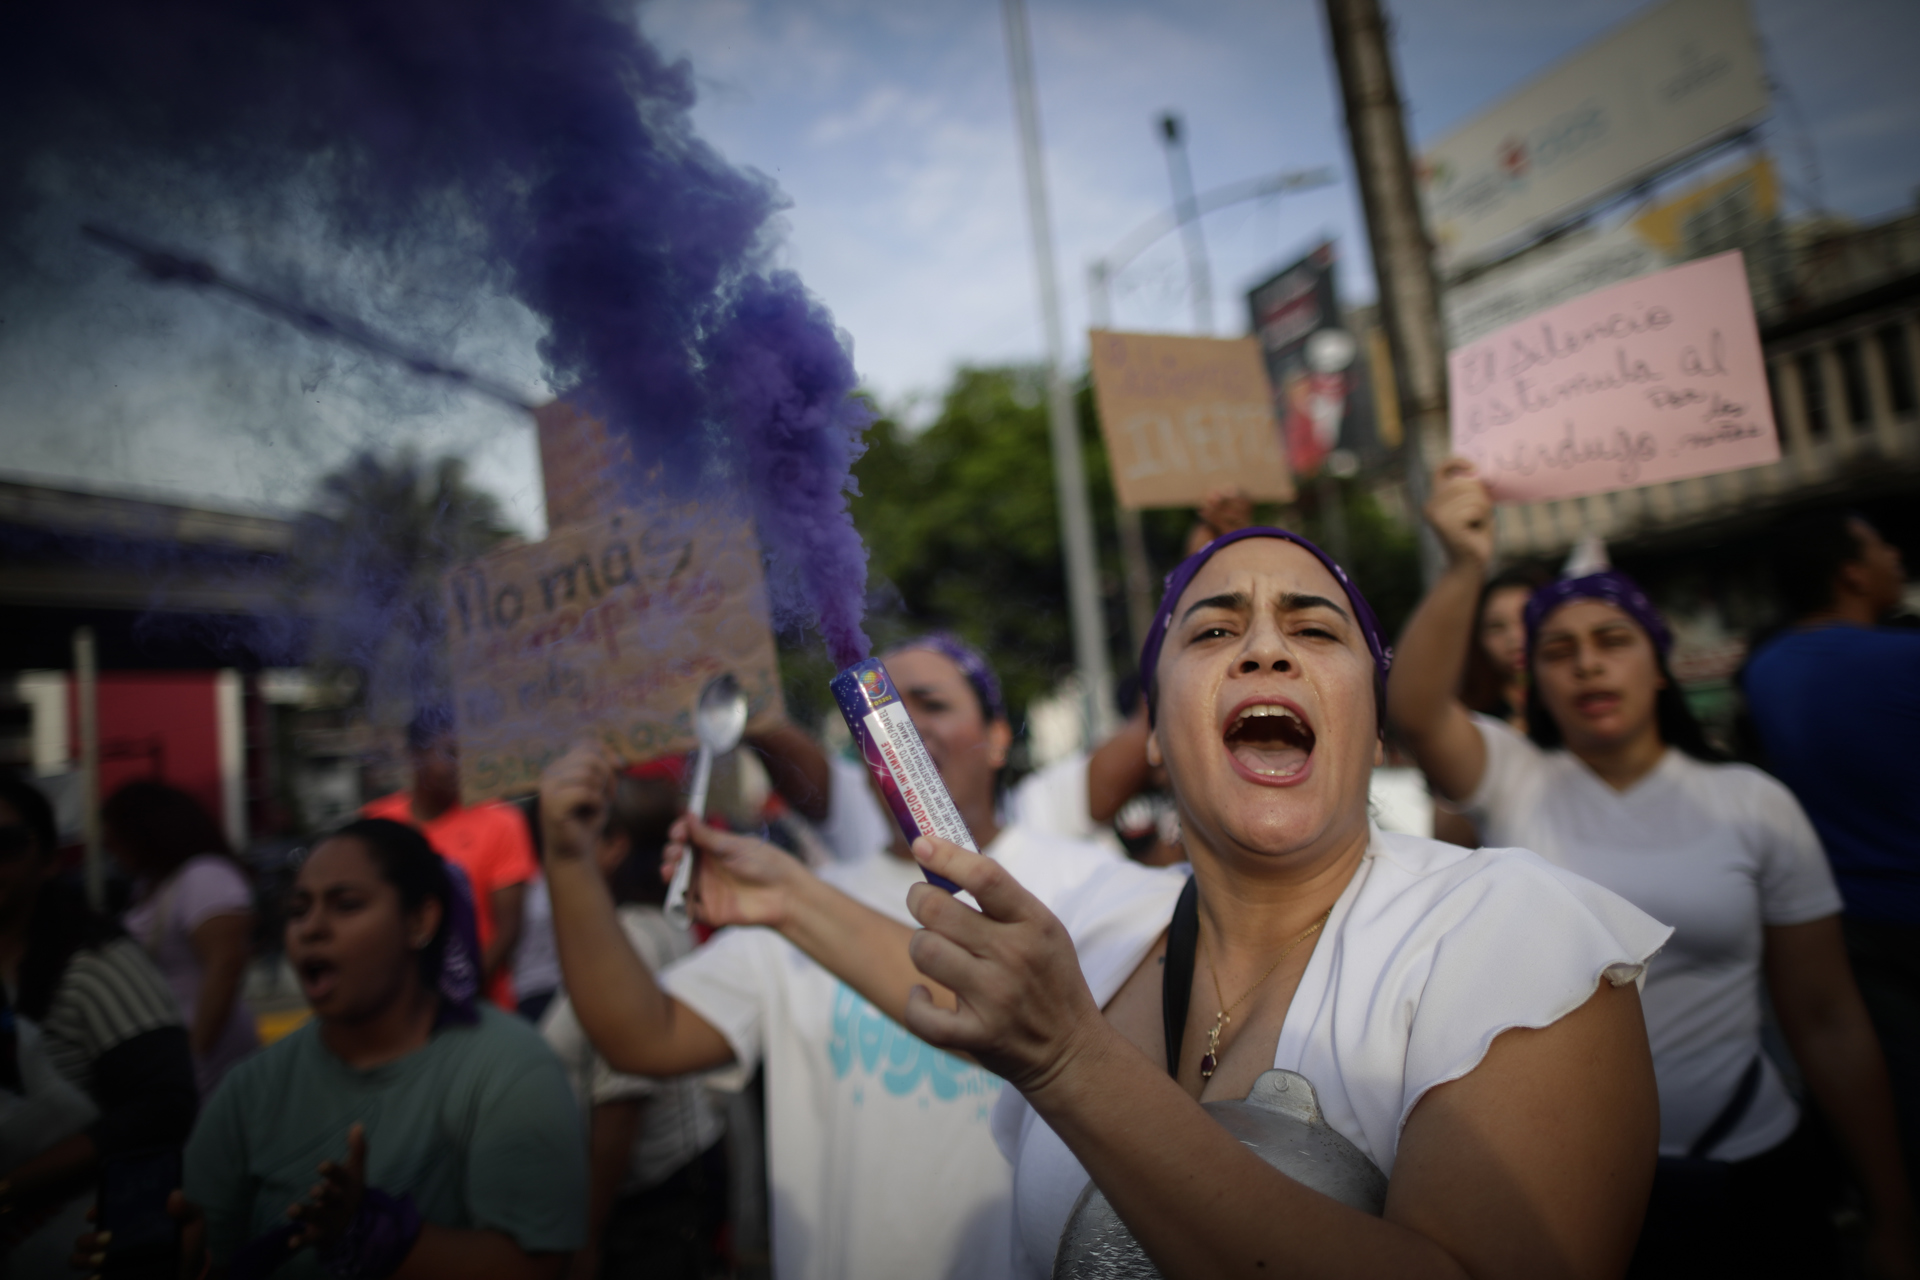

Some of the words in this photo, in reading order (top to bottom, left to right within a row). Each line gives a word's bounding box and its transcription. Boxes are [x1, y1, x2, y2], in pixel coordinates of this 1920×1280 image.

[877, 708, 888, 718] EL
[881, 716, 896, 734] PARA
[889, 731, 904, 749] SOLO
[903, 737, 914, 748] LA
[907, 745, 918, 756] EN
[879, 740, 909, 786] INFLAMABLE
[920, 750, 939, 780] ENCIENDA
[912, 753, 933, 786] SOSTENGA
[909, 771, 920, 782] UN
[914, 780, 924, 790] DE
[927, 783, 938, 795] NO
[918, 788, 943, 827] SUPERVISION
[945, 798, 953, 807] EL
[948, 805, 957, 815] EN
[941, 811, 955, 827] AIRE
[937, 825, 947, 835] LA
[948, 825, 958, 835] AL
[952, 813, 971, 843] COLOCAR
[952, 833, 965, 847] USO
